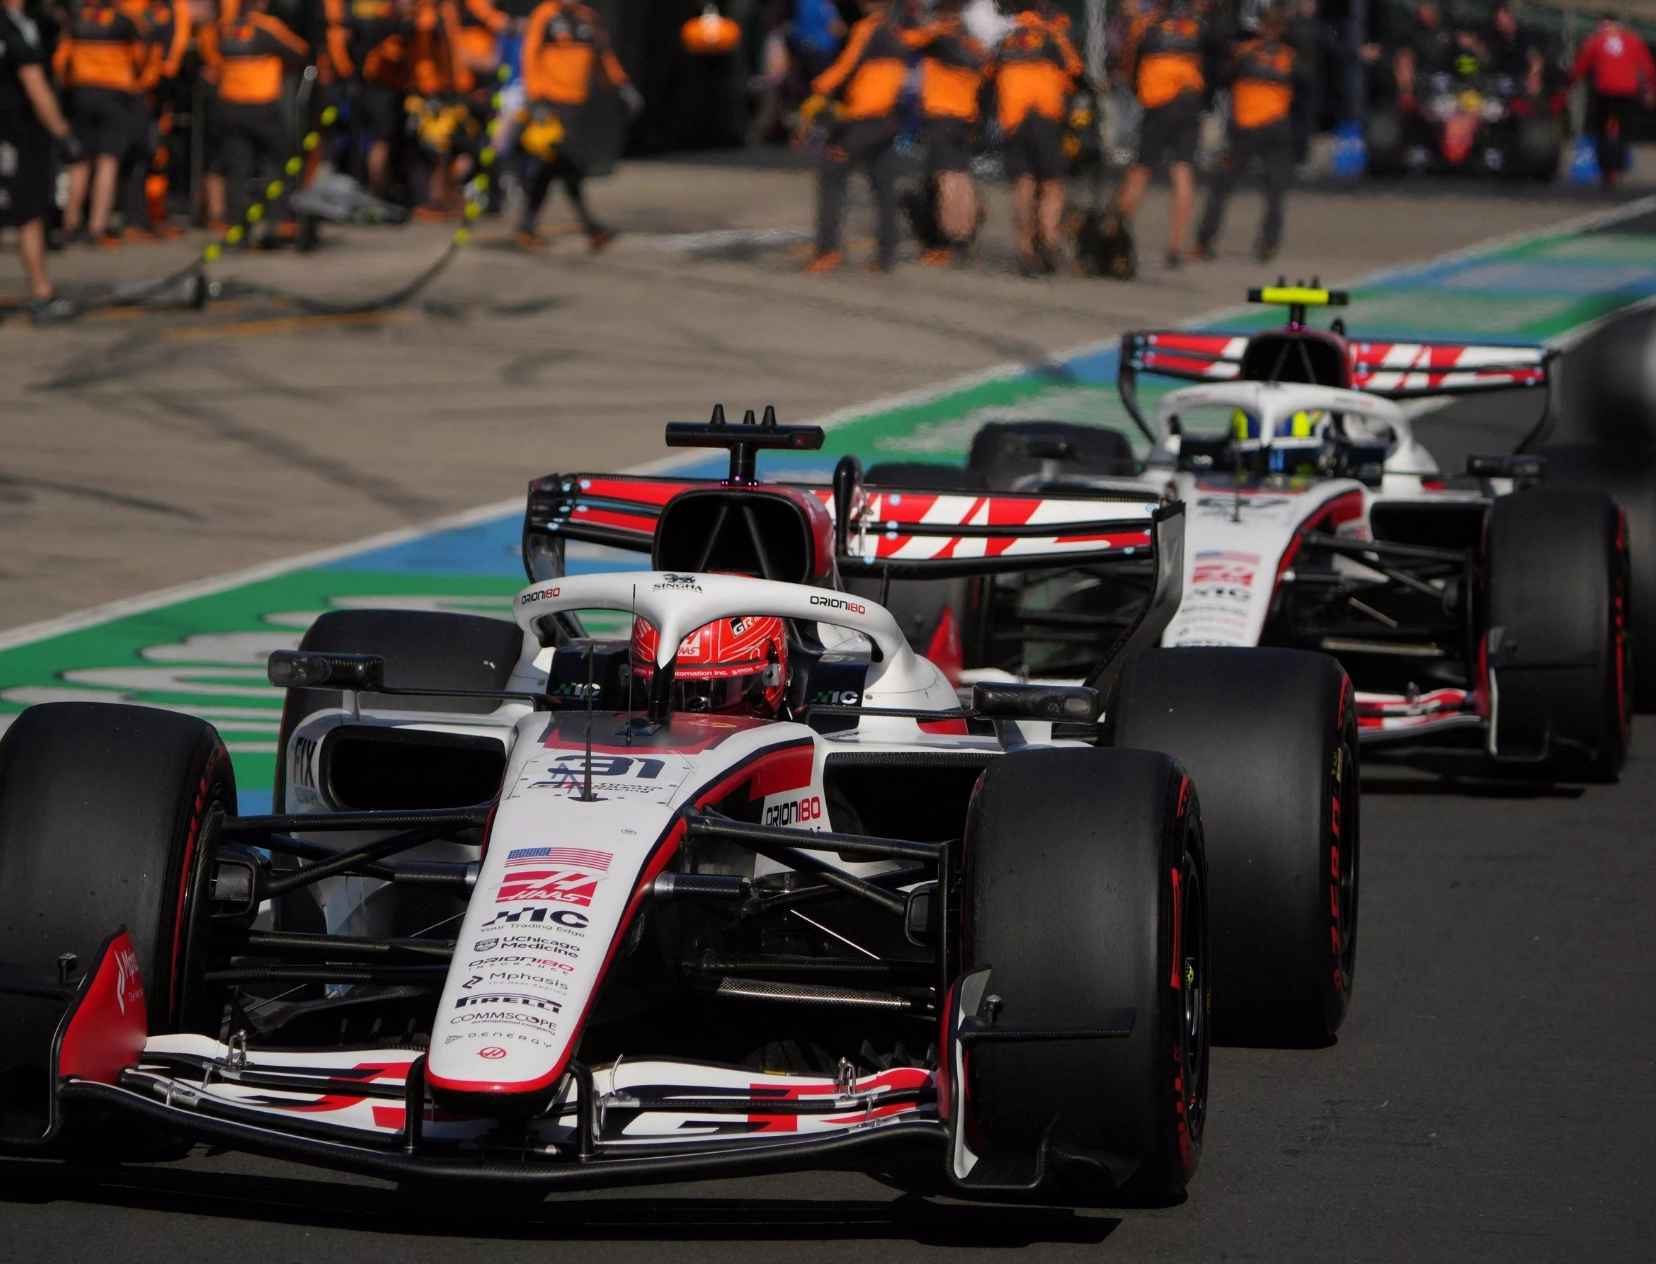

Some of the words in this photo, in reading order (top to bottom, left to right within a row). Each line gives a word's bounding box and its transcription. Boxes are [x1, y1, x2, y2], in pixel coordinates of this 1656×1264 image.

[547, 755, 666, 780] 31
[500, 943, 579, 959] Medicine
[489, 972, 569, 991] Mphasis
[455, 993, 563, 1014] PIRELLI
[450, 1012, 558, 1030] COMMSCOPE
